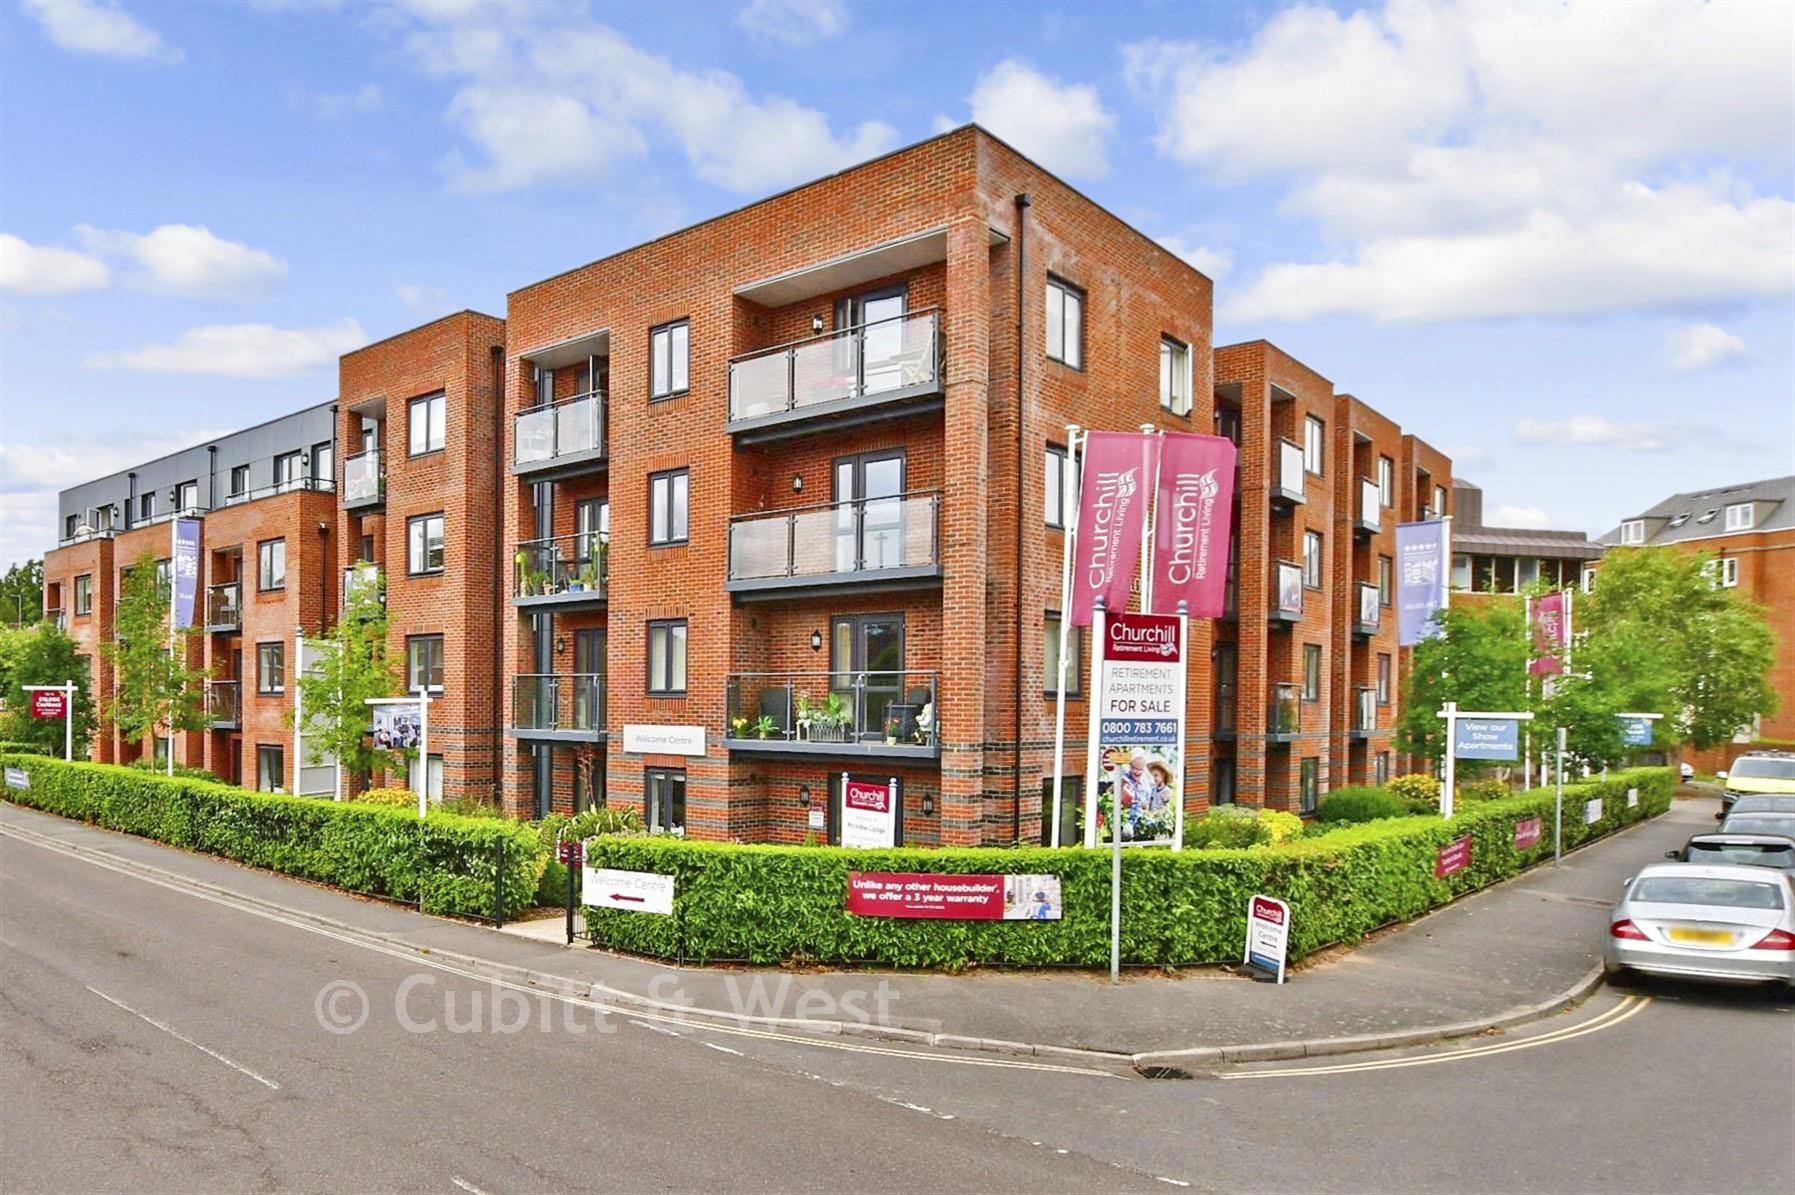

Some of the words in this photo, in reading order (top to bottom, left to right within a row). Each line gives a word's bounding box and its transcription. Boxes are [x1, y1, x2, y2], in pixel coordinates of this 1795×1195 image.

[1202, 498, 1215, 526] Living
[1089, 472, 1120, 589] Churchill
[1168, 473, 1200, 585] Churchill
[1105, 529, 1121, 583] Retirement
[1114, 498, 1130, 527] Living
[1196, 527, 1211, 580] Retirement
[1110, 622, 1176, 643] Churchill
[1112, 643, 1143, 653] Retirement
[1144, 645, 1161, 655] Living
[1111, 667, 1172, 679] RETIREMENT
[1109, 683, 1174, 695] APARTMENTS
[1110, 699, 1137, 713] FOR
[1140, 699, 1171, 713] SALE
[1102, 722, 1131, 734] 0800
[1134, 722, 1153, 734] 783
[1154, 722, 1177, 734] 7661
[1465, 723, 1488, 731] View
[1489, 724, 1507, 732] our
[634, 733, 667, 744] Welcome
[668, 735, 692, 745] Centre
[1471, 732, 1499, 741] Show
[1457, 742, 1513, 752] Apartments
[849, 787, 885, 803] Churchill
[590, 874, 631, 888] Welcome
[634, 878, 666, 892] Centre
[852, 879, 883, 890] Unlike
[885, 883, 903, 892] any
[905, 882, 931, 892] other
[862, 892, 877, 901] we
[879, 892, 903, 902] offer
[913, 893, 921, 902] 3
[922, 895, 944, 904] year
[946, 893, 989, 904] warranty
[1255, 904, 1283, 918] Churchill
[1258, 930, 1278, 942] Centre
